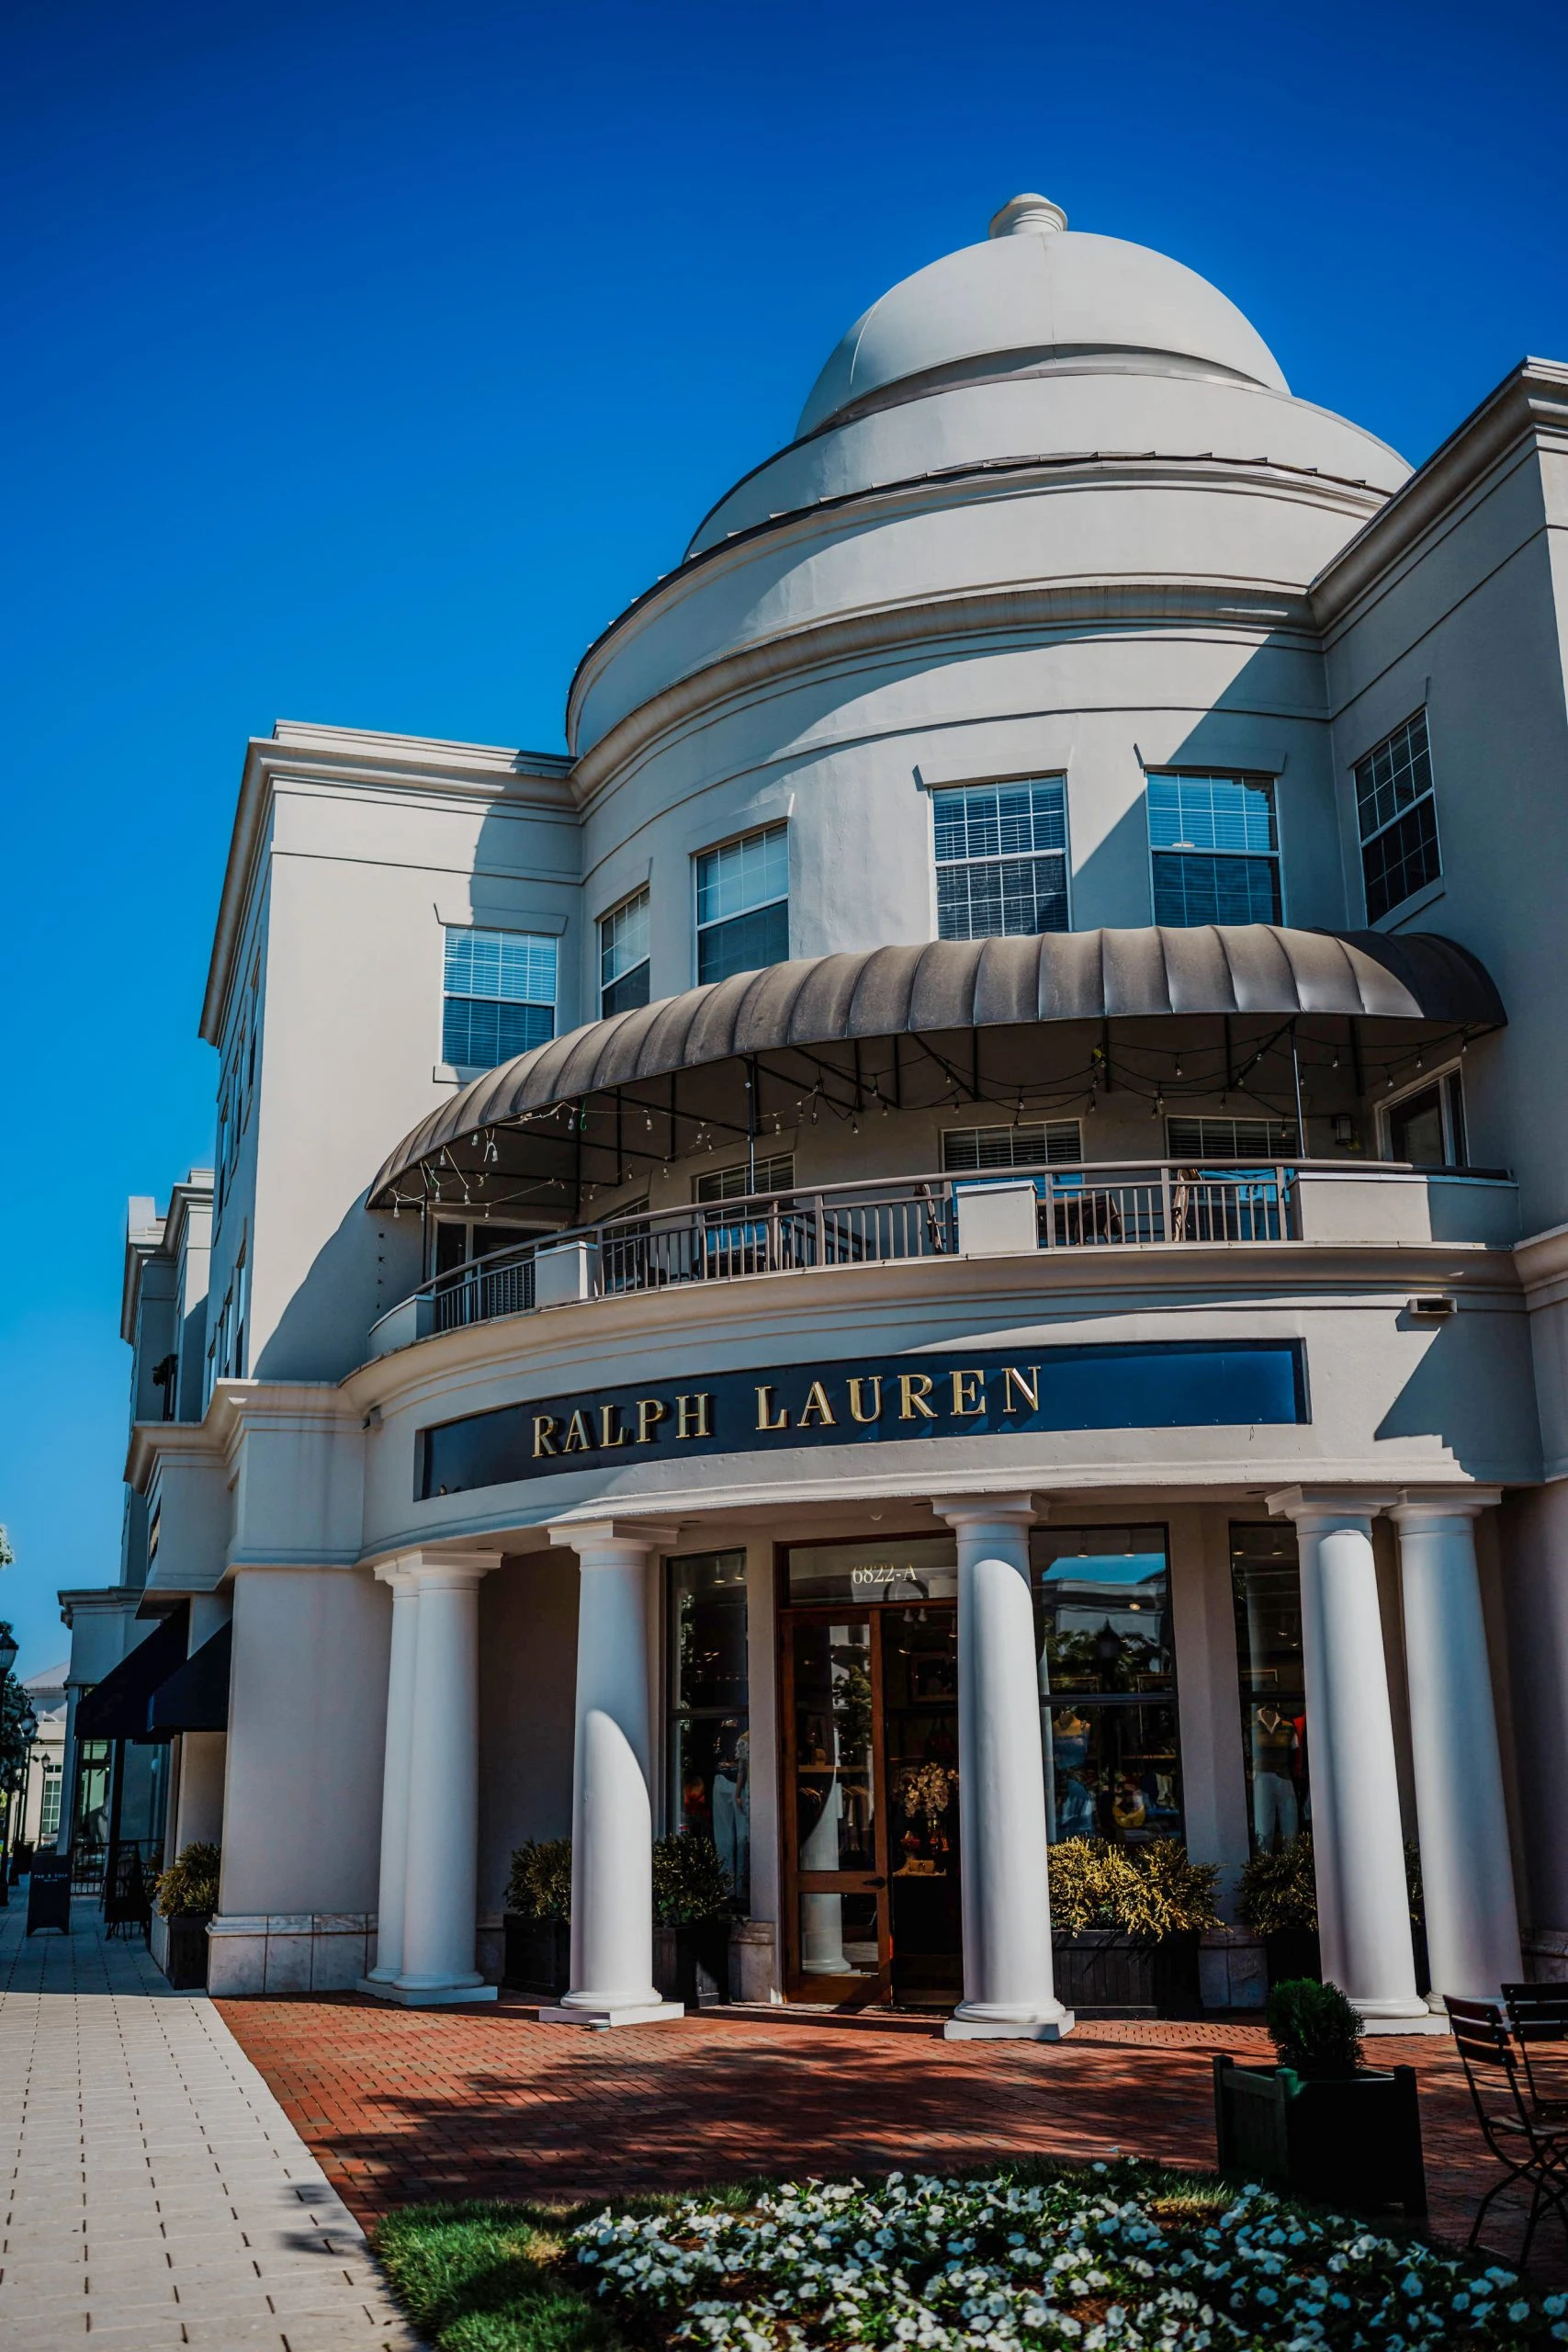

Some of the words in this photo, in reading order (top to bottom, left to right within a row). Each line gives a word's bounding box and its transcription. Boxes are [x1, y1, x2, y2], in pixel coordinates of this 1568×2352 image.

[531, 1393, 712, 1458] RALPH
[754, 1365, 1041, 1430] LAUREN
[852, 1563, 918, 1585] 6822-A
